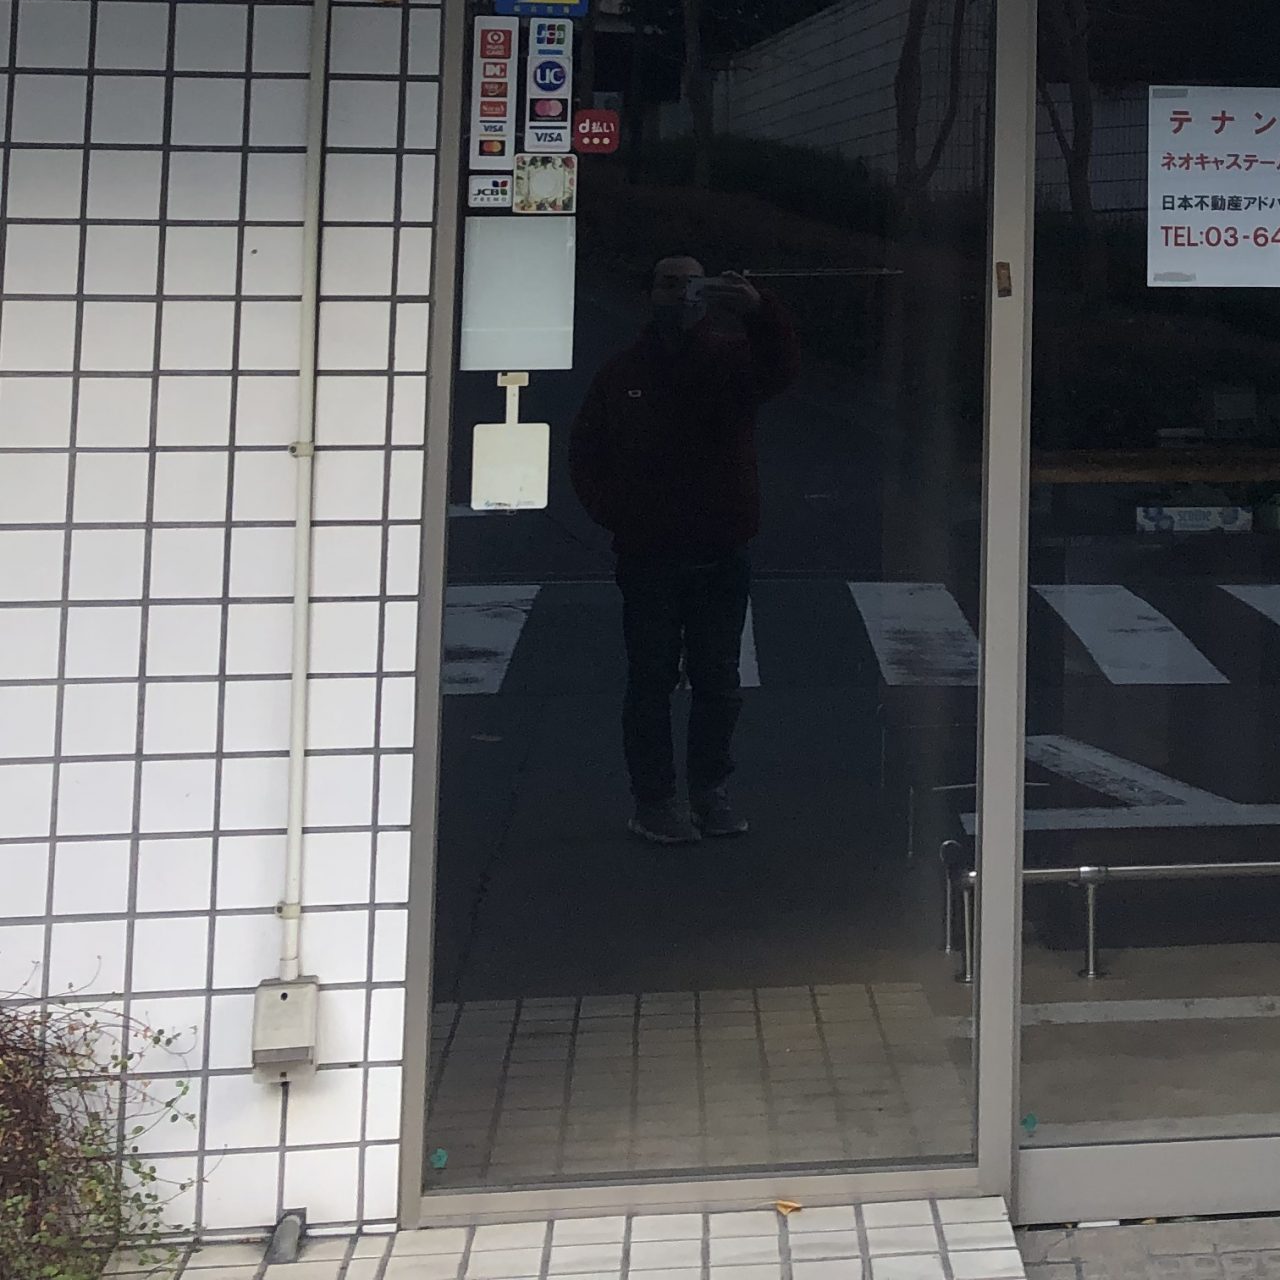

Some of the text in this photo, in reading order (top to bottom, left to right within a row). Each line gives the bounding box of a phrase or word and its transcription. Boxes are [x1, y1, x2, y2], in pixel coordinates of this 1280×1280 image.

[536, 68, 564, 85] UC
[535, 133, 563, 142] VISA
[472, 188, 499, 196] JCB
